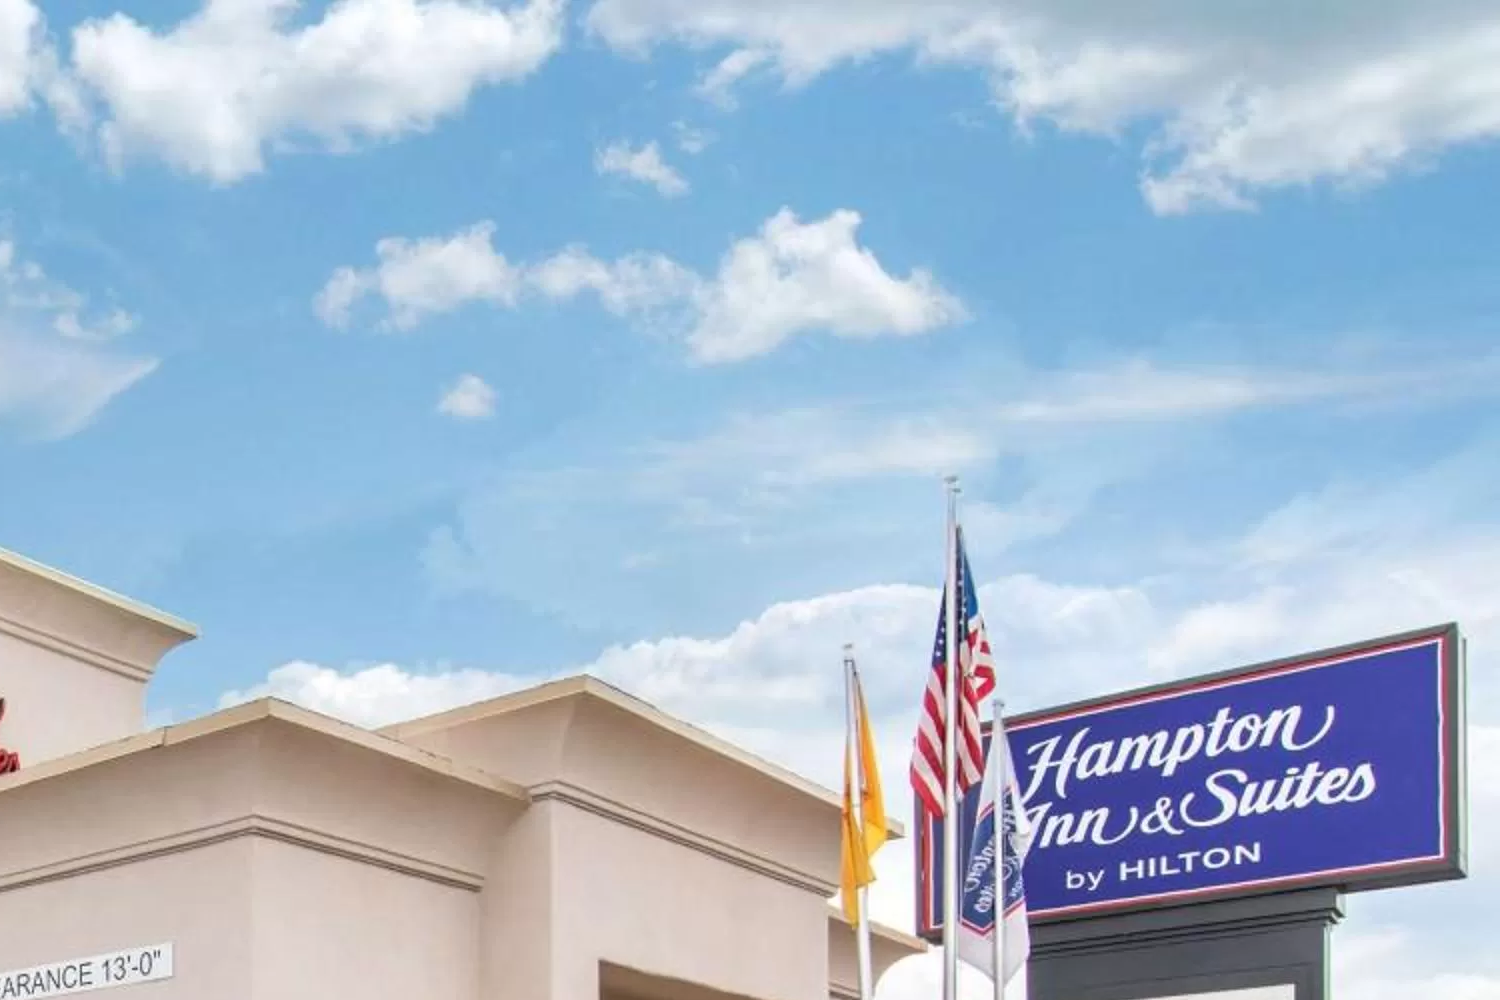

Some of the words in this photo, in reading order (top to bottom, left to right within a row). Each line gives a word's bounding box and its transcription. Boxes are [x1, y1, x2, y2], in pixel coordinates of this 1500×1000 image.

[1021, 704, 1336, 805] Hampton
[1139, 796, 1185, 836] &
[1179, 761, 1376, 827] Suites
[1065, 868, 1105, 892] by
[1119, 842, 1261, 882] HILTON
[101, 949, 162, 982] 13'-0"
